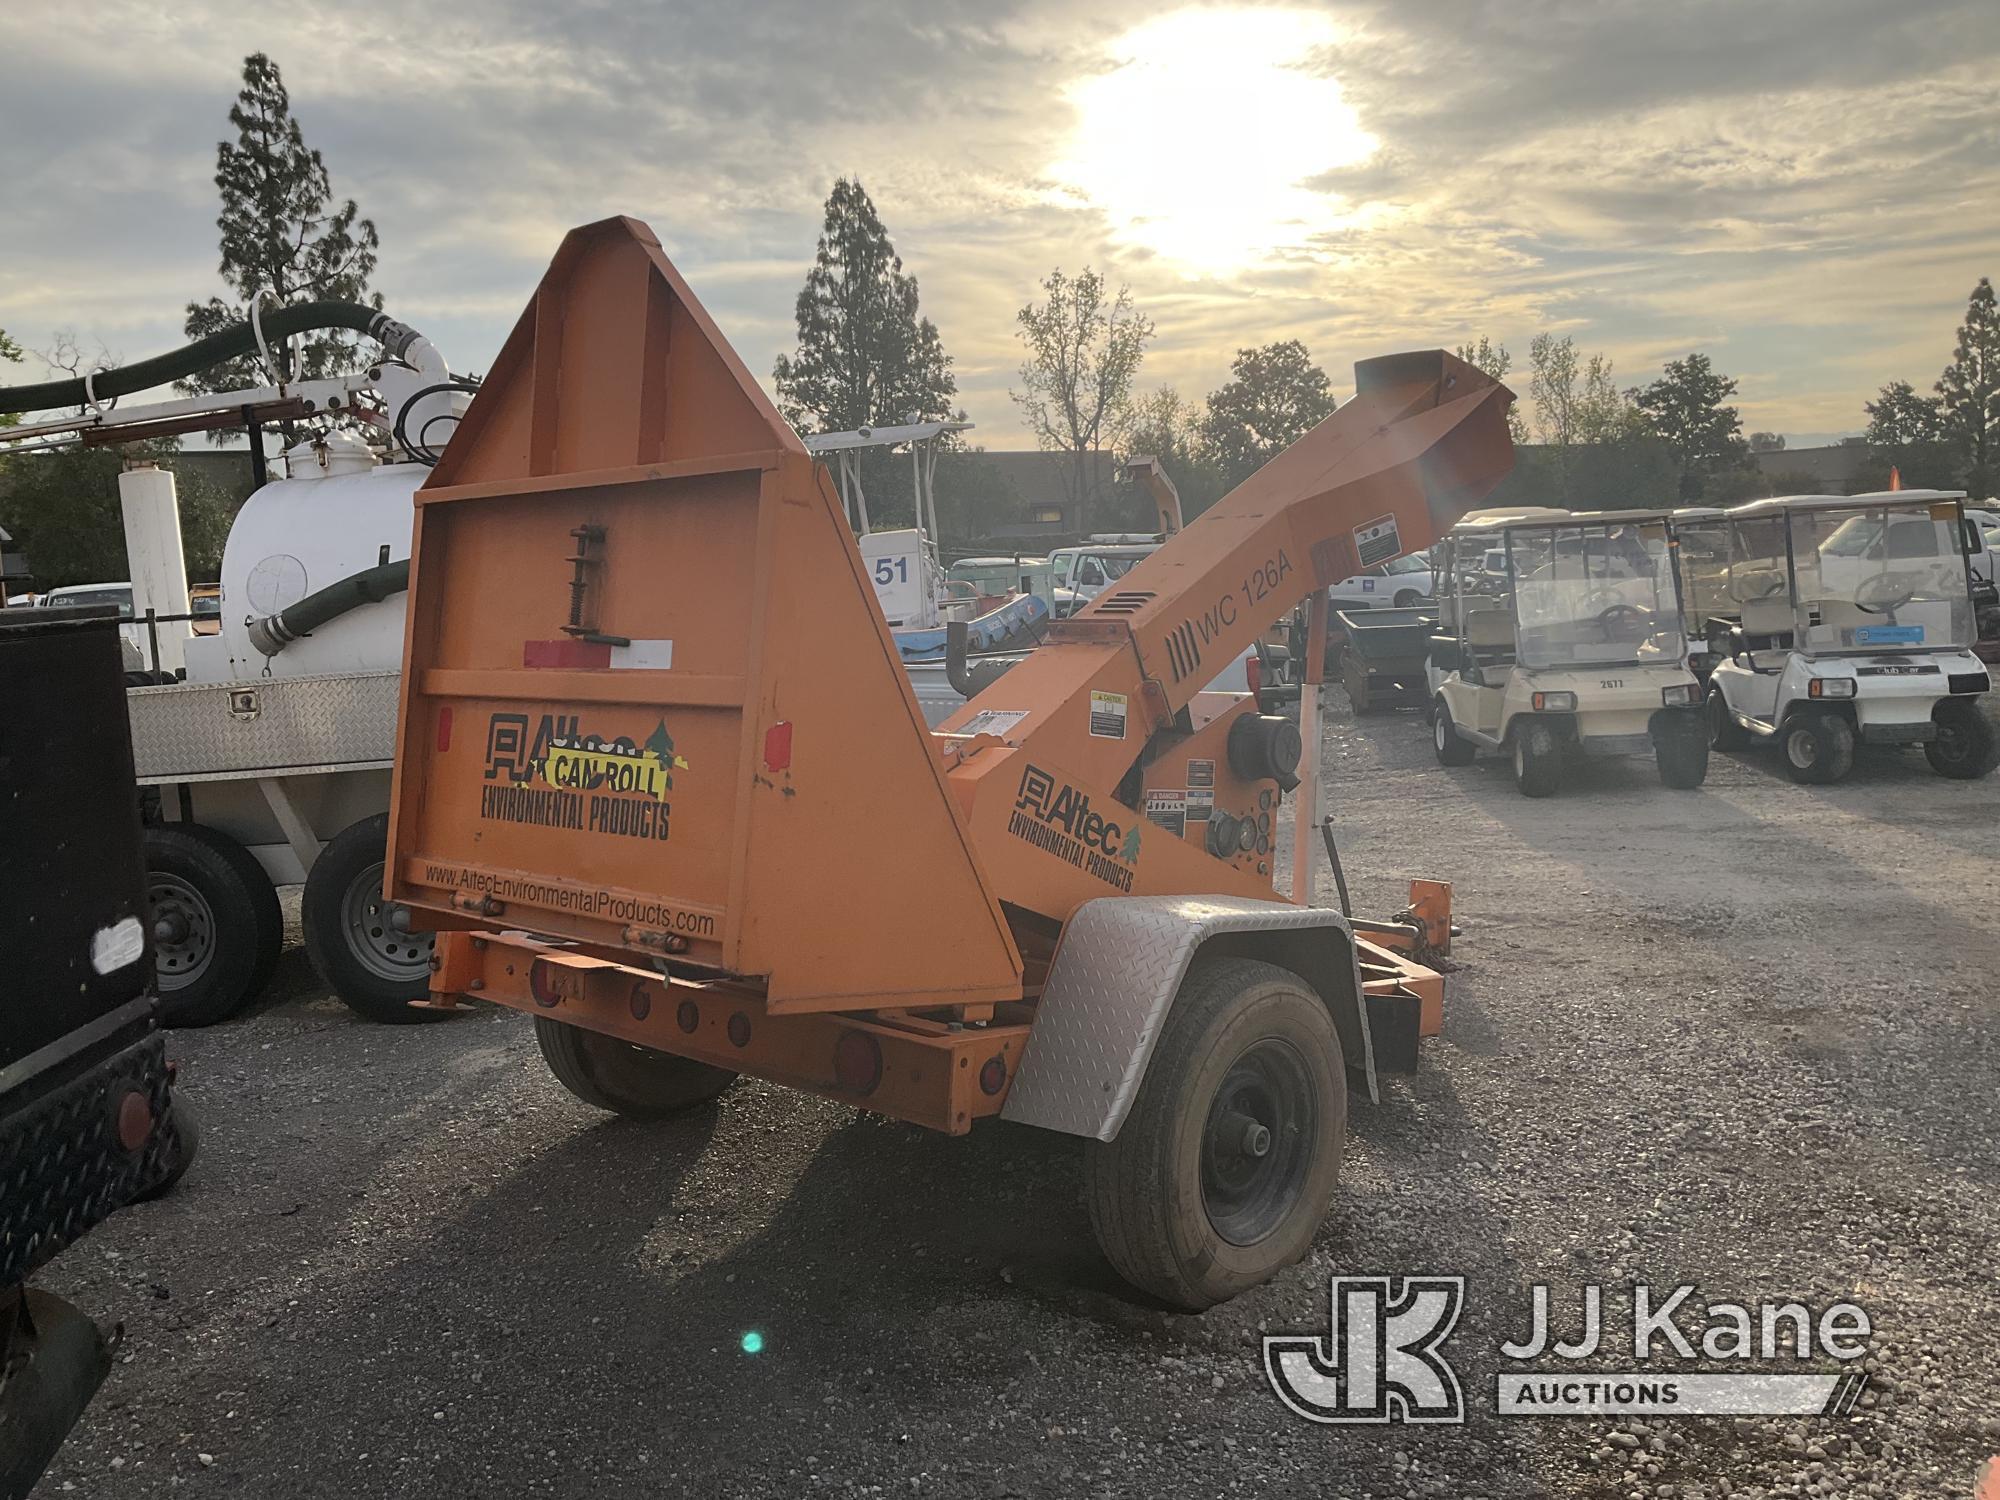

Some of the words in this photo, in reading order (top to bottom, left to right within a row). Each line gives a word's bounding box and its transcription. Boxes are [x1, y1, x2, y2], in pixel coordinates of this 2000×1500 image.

[875, 557, 907, 586] 51
[1196, 594, 1238, 645] WC
[1240, 549, 1294, 608] 126A
[606, 761, 659, 799] ROLL
[481, 784, 584, 831] ENVIRONMENTAL
[588, 796, 671, 841] PRODUCTS
[1046, 784, 1121, 856] Altec
[1007, 810, 1086, 870] ENVIRONMENTAL
[1085, 853, 1134, 893] PRODUCTS
